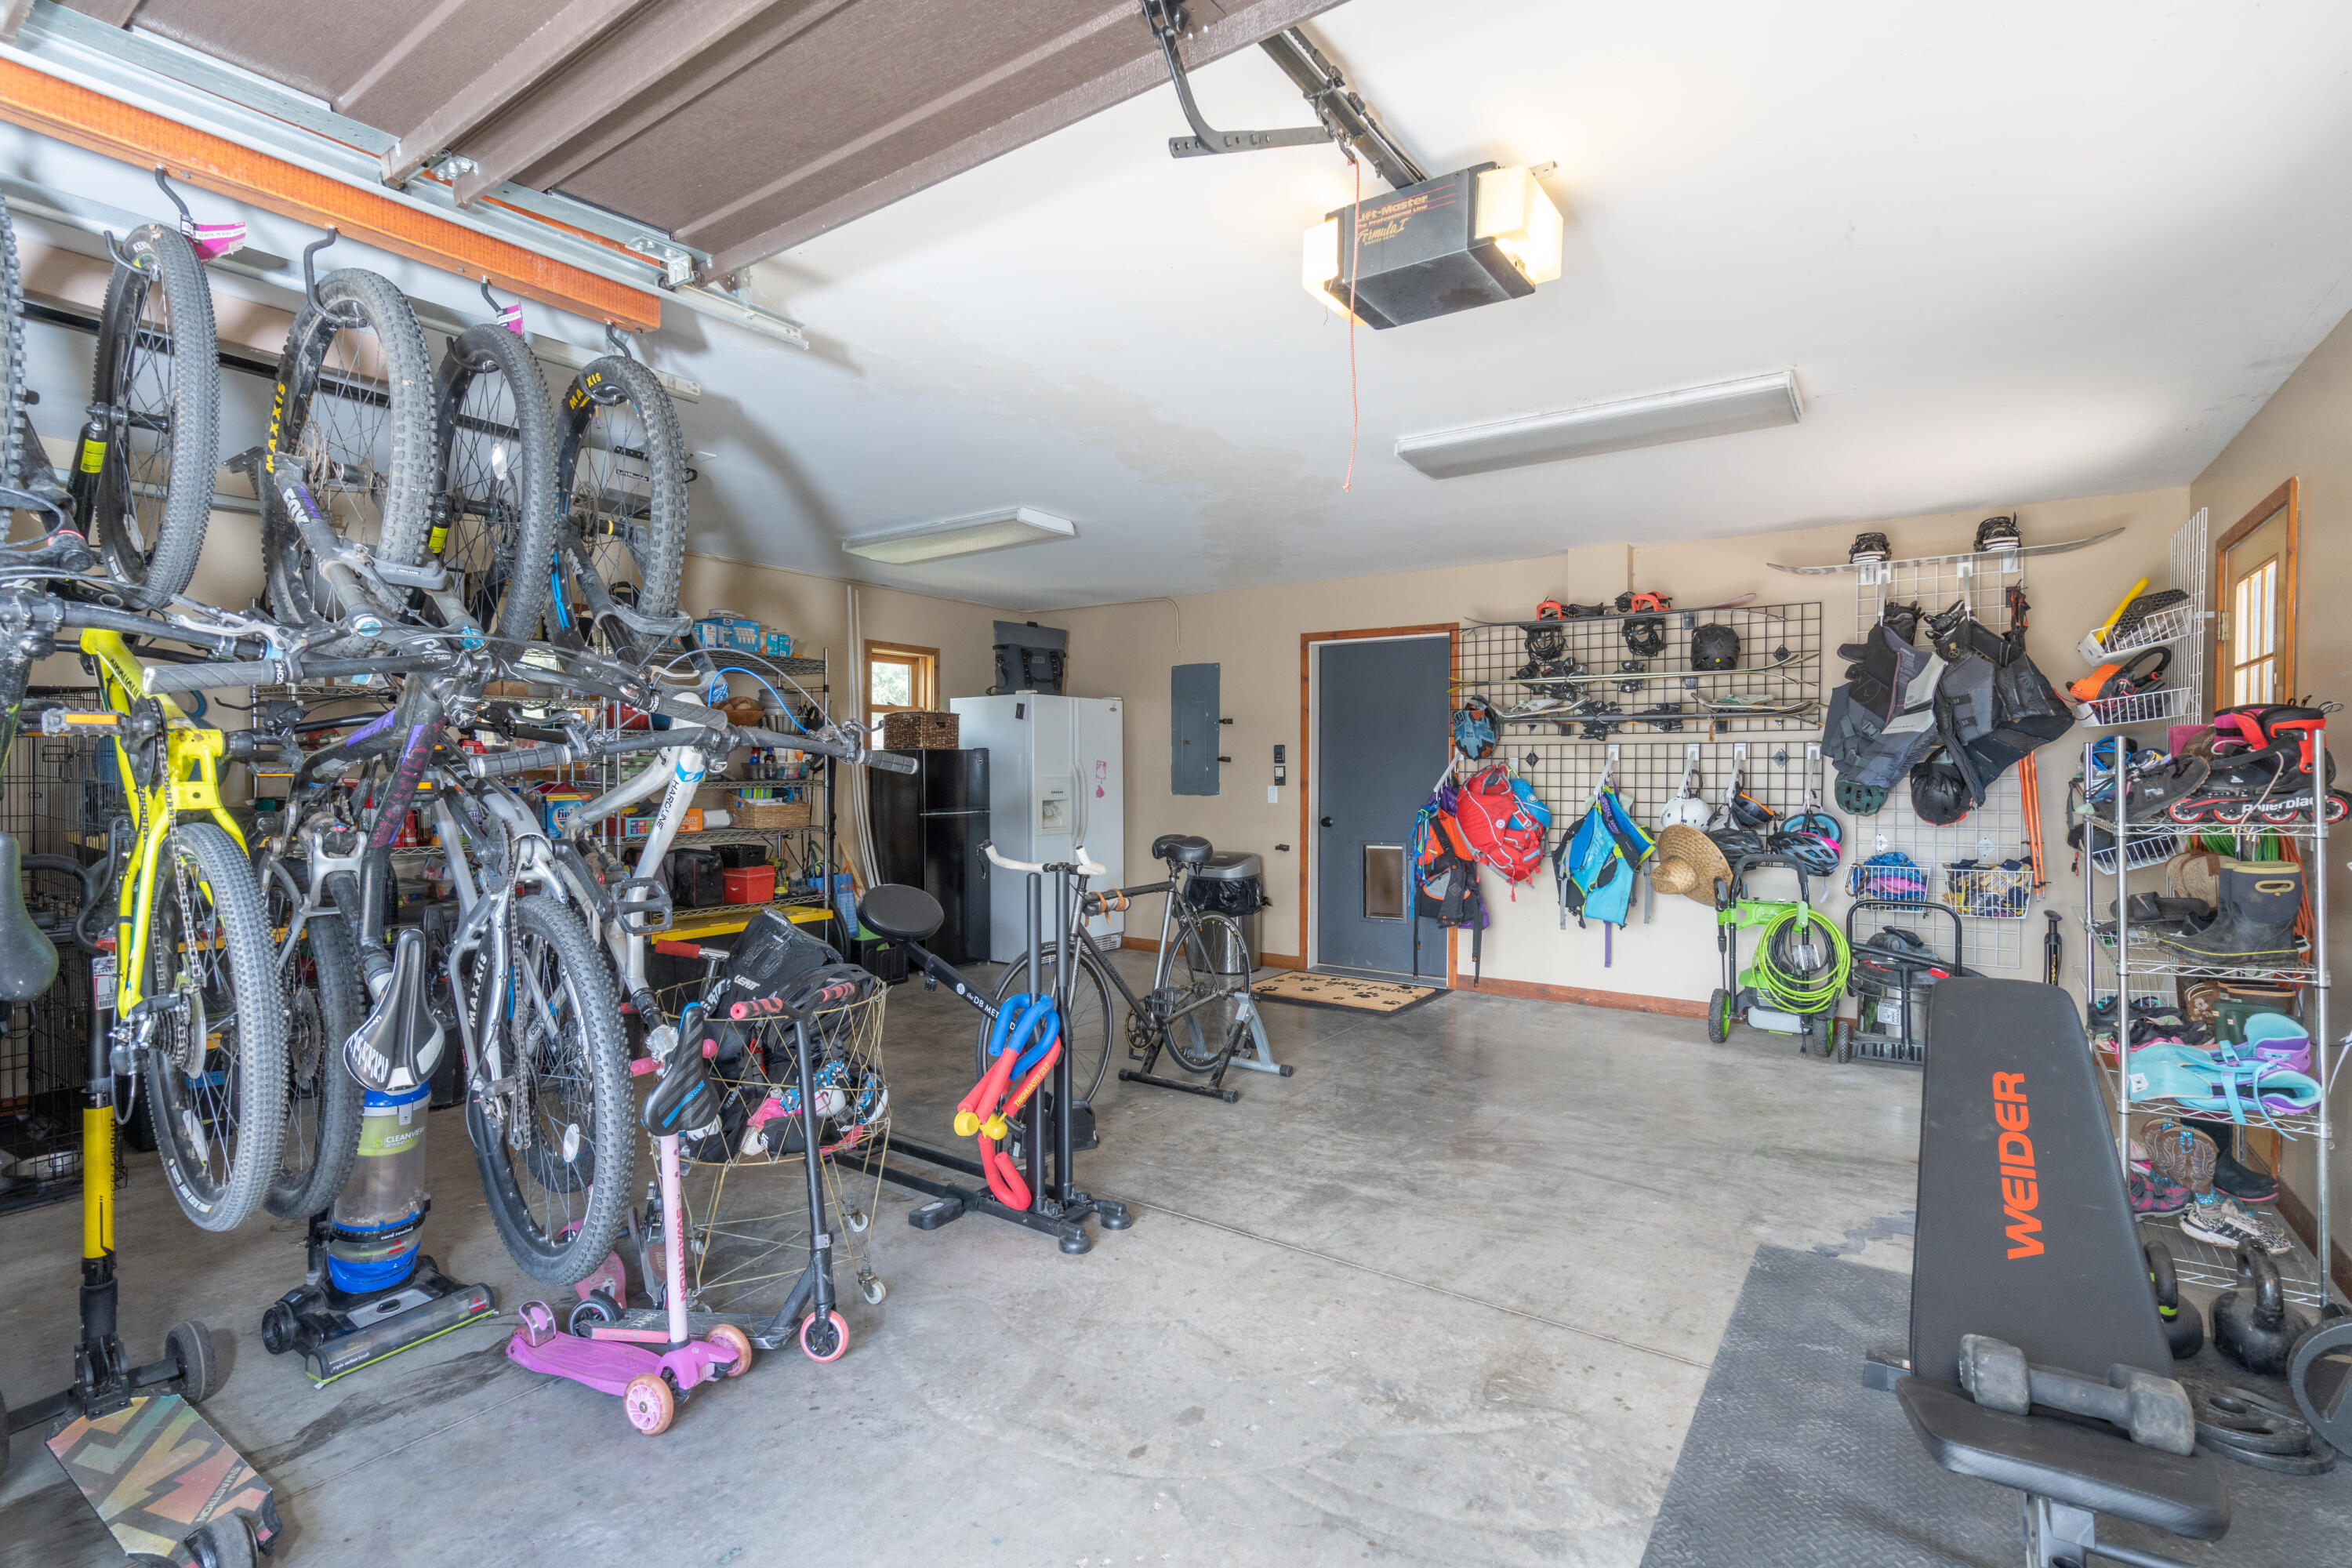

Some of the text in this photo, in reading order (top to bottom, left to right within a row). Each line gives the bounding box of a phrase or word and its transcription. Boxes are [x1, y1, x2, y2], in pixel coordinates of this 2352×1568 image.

[568, 372, 601, 410] MAXIS
[266, 381, 285, 474] MAXXIS
[282, 488, 310, 524] FOX
[2241, 795, 2314, 814] Rllerbla
[469, 953, 487, 1028] MAXXIS
[734, 975, 760, 990] LEATT
[973, 996, 983, 1007] DB
[1014, 1075, 1041, 1107] THIGHMASTER
[1992, 1071, 2045, 1260] WEIDER
[381, 1225, 413, 1240] cord rewind
[676, 1207, 687, 1302] SWAGTRON
